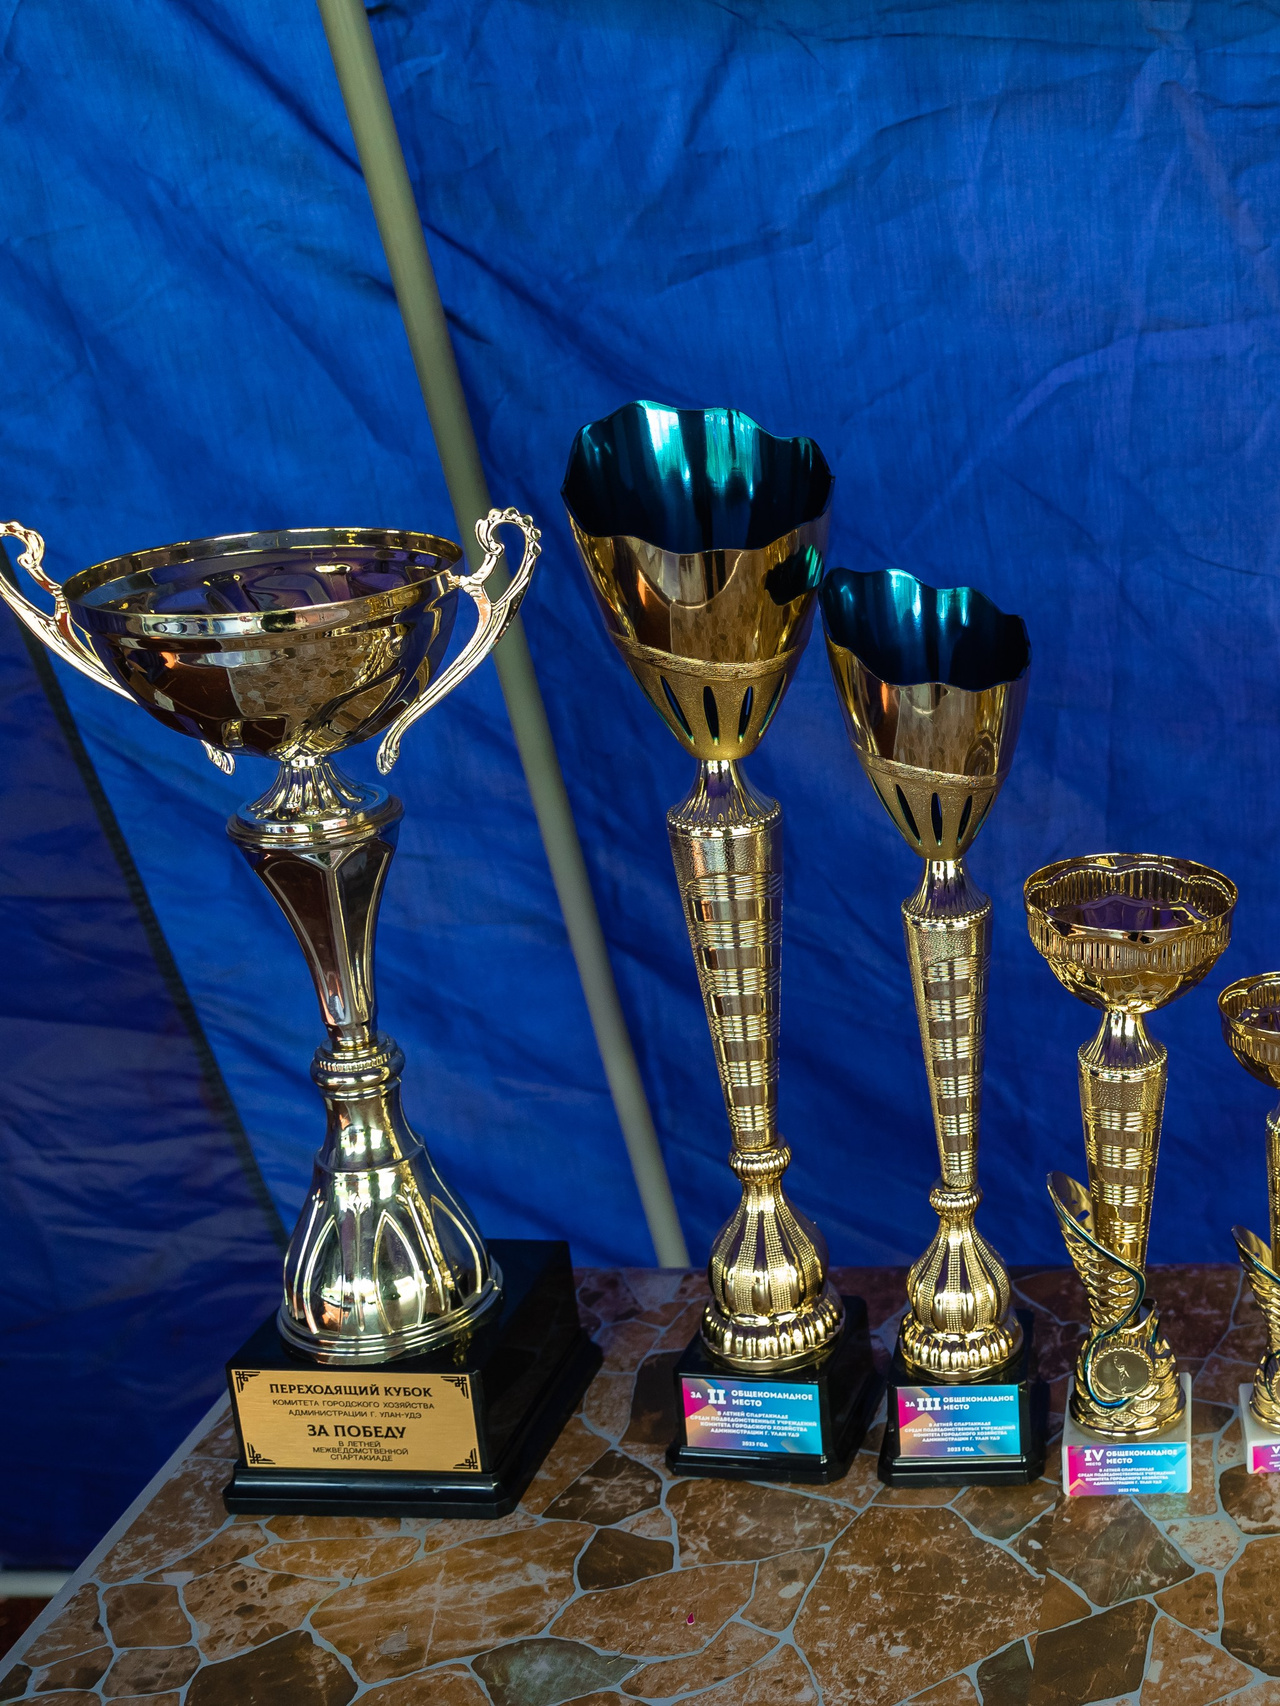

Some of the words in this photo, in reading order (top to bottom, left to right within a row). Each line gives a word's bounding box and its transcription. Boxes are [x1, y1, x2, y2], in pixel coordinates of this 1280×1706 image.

[270, 1383, 380, 1396] ПЕРЕХОДЯЩИЙ
[384, 1386, 433, 1397] КУБОК
[707, 1389, 726, 1404] II
[731, 1390, 813, 1400] ОБЩЕКОМАНДНОЕ
[917, 1398, 941, 1411] III
[288, 1410, 367, 1418] АДМИНИСТРАЦИИ
[711, 1416, 776, 1424] ПОДВЕДОМСТВЕННЫХ
[307, 1425, 328, 1437] ЗА
[334, 1425, 406, 1438] ПОБЕДУ
[348, 1440, 381, 1448] ЛЕТНЕЙ
[313, 1447, 408, 1455] МЕЖВЕДОМСТВЕННОЙ
[1084, 1449, 1104, 1461] IV
[1106, 1449, 1177, 1457] ОБЩЕКОМАНДНОЕ
[1272, 1446, 1280, 1454] V
